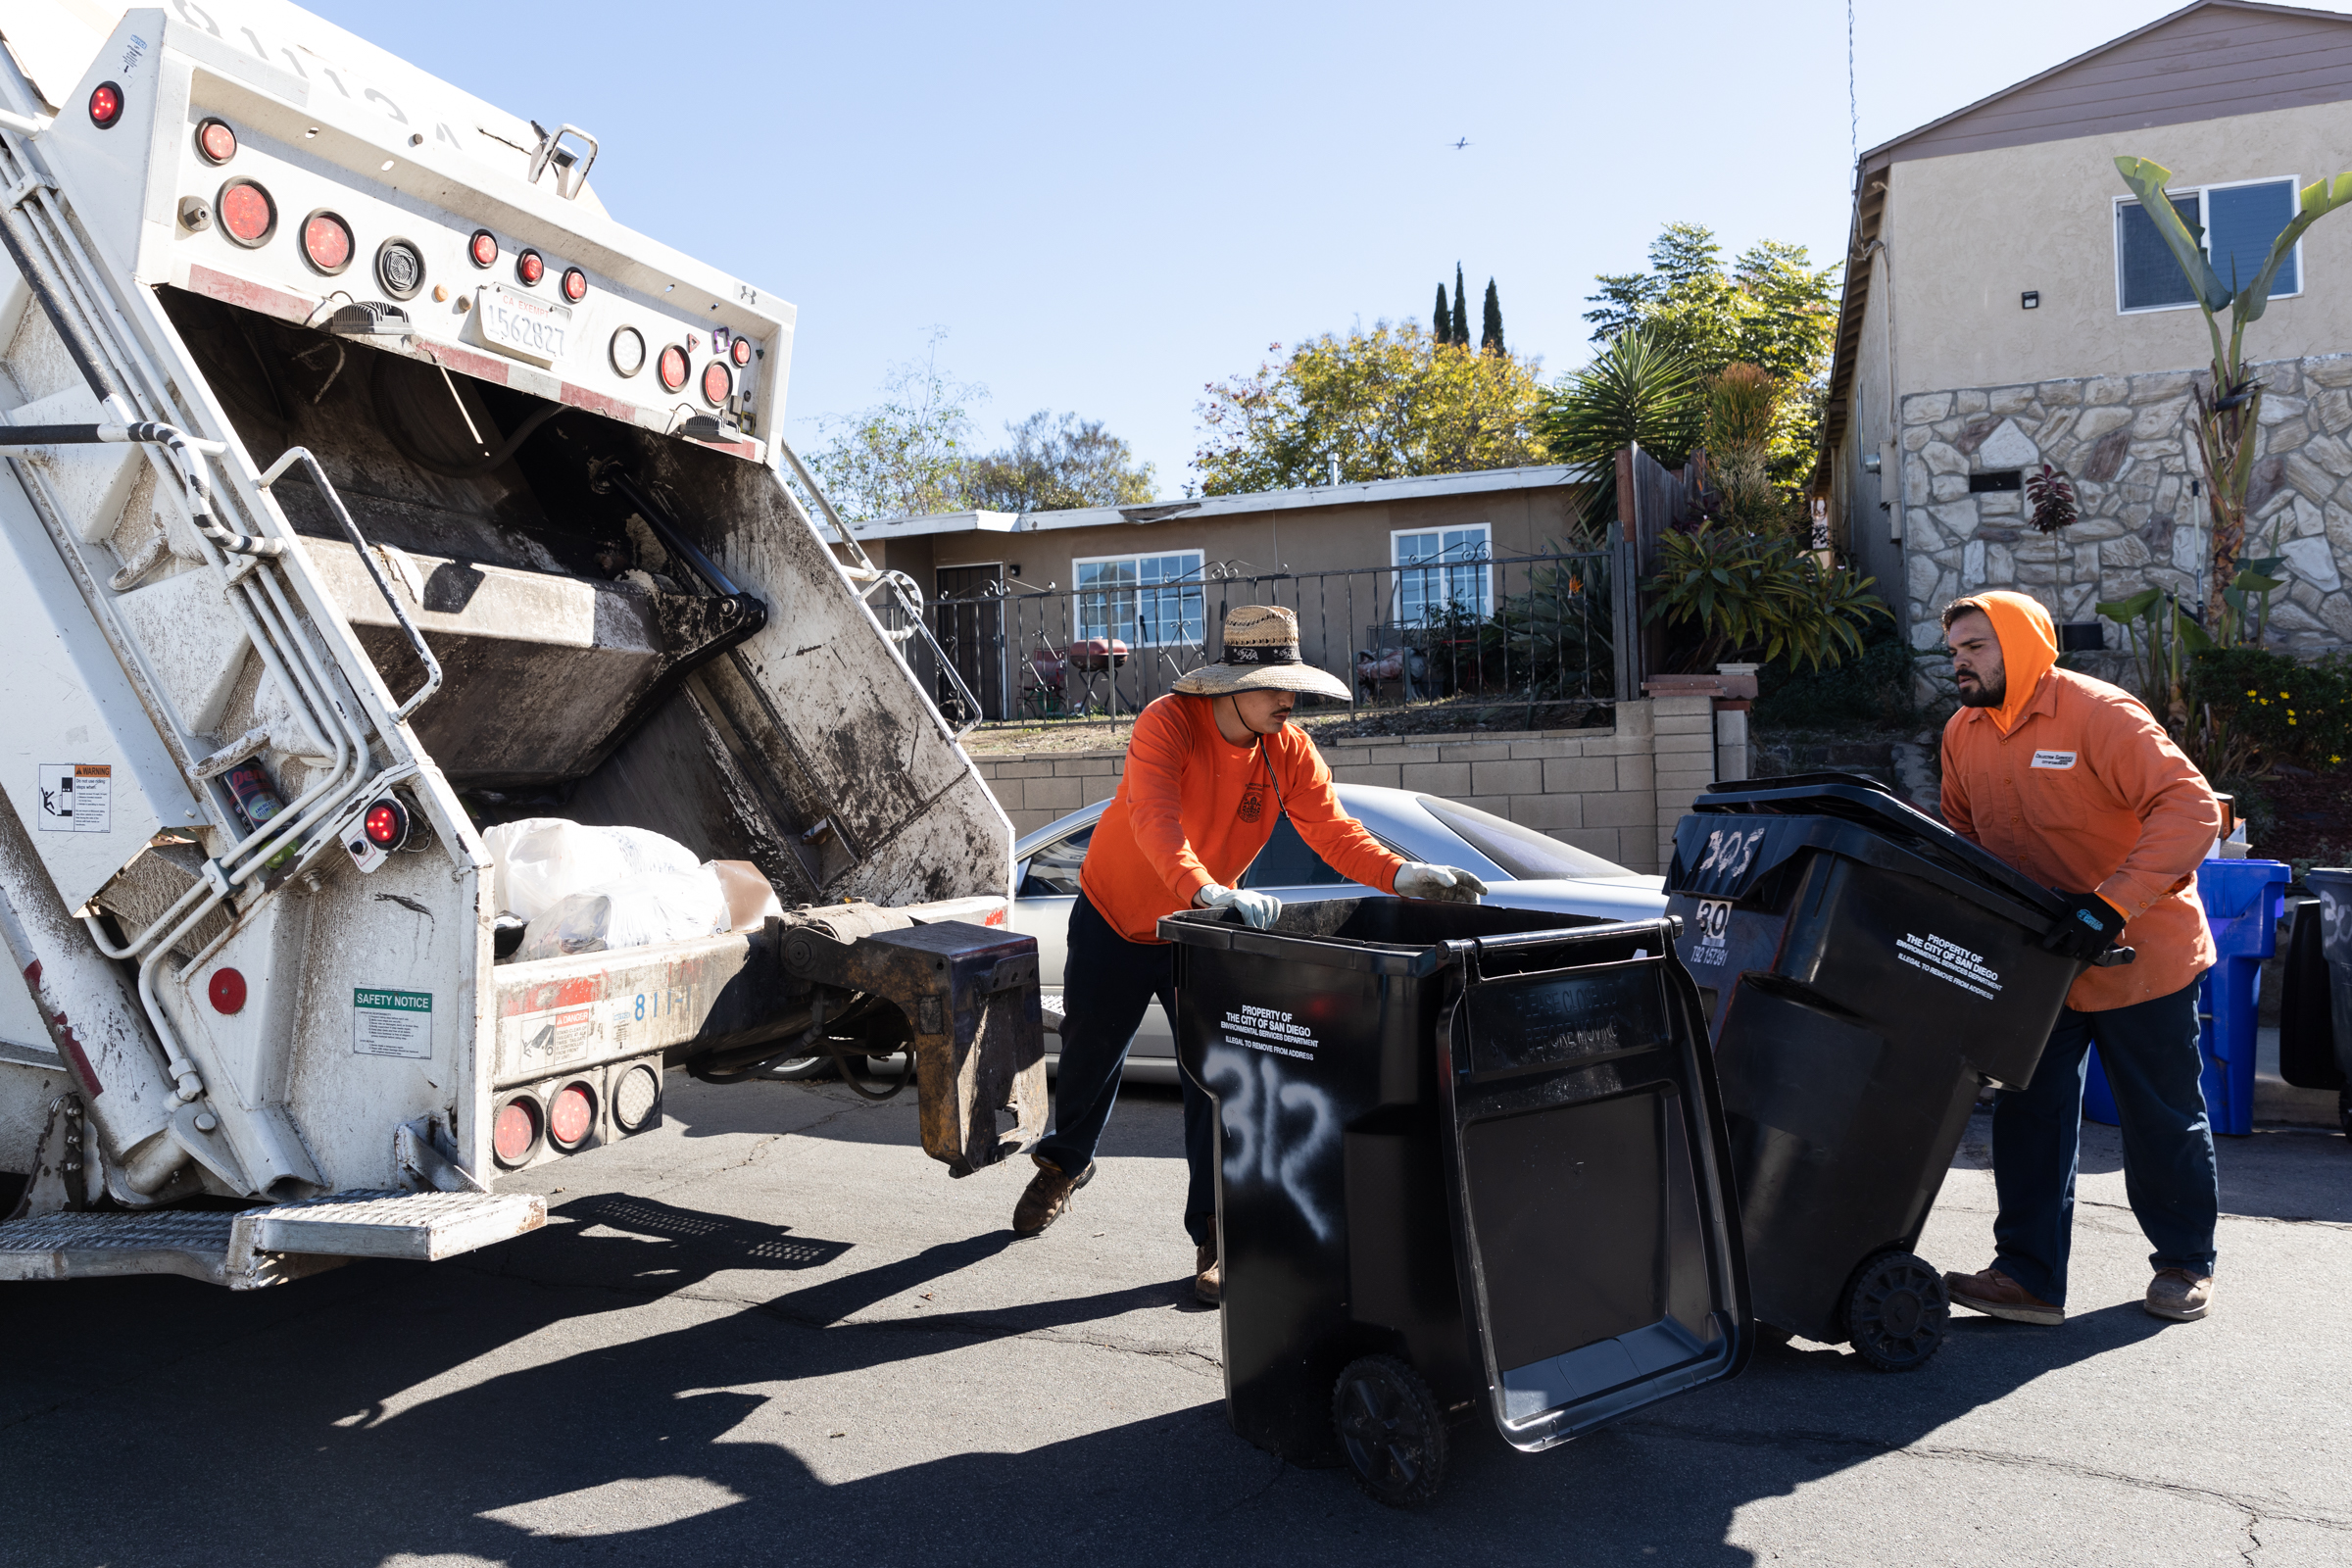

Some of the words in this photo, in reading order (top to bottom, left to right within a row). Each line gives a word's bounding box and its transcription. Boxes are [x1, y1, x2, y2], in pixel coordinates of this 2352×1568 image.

[503, 295, 514, 306] CA
[518, 300, 549, 318] EXEMPT
[489, 305, 564, 357] 1562827
[82, 766, 110, 776] WARNING
[1699, 827, 1764, 878] 305
[1699, 903, 1728, 937] 30
[1690, 946, 1705, 962] T92
[1907, 933, 1924, 947] THE
[1924, 942, 1942, 956] CITY
[1942, 951, 1956, 961] OF
[1955, 956, 1972, 970] SAN
[1974, 964, 1998, 980] DIEGO
[1927, 933, 1971, 958] PROPERTY
[1971, 953, 1984, 963] OF
[1896, 939, 1940, 963] ENVIRONMENTAL
[1941, 959, 1968, 976] SERVICES
[1968, 971, 2003, 991] DEPARTMENT
[1897, 953, 1921, 967] ILLEGAL
[1922, 962, 1930, 971] TO
[1930, 966, 1953, 982] REMOVE
[1953, 978, 1970, 989] FROM
[1969, 984, 1994, 1001] ADDRESS
[357, 993, 392, 1005] SAFETY
[394, 996, 428, 1008] NOTICE
[1562, 985, 1599, 1012] CLOSE
[564, 1011, 588, 1024] DANGER
[1226, 1011, 1240, 1023] THE
[1241, 1015, 1256, 1027] CITY
[1257, 1018, 1268, 1029] OF
[1269, 1021, 1285, 1033] SAN
[1287, 1024, 1311, 1037] DIEGO
[1242, 1004, 1280, 1020] PROPERTY
[1282, 1012, 1293, 1023] OF
[1221, 1021, 1258, 1036] ENVIRONMENTAL
[1259, 1029, 1283, 1041] SERVICES
[1284, 1035, 1319, 1048] DEPARTMENT
[1525, 1022, 1577, 1051] BEFORE
[1576, 1015, 1618, 1044] MOVING
[1225, 1035, 1244, 1046] ILLEGAL
[1245, 1040, 1251, 1049] TO
[1252, 1042, 1273, 1053] REMOVE
[1274, 1046, 1288, 1055] FROM
[1289, 1049, 1313, 1060] ADDRESS
[1203, 1043, 1331, 1241] 312
